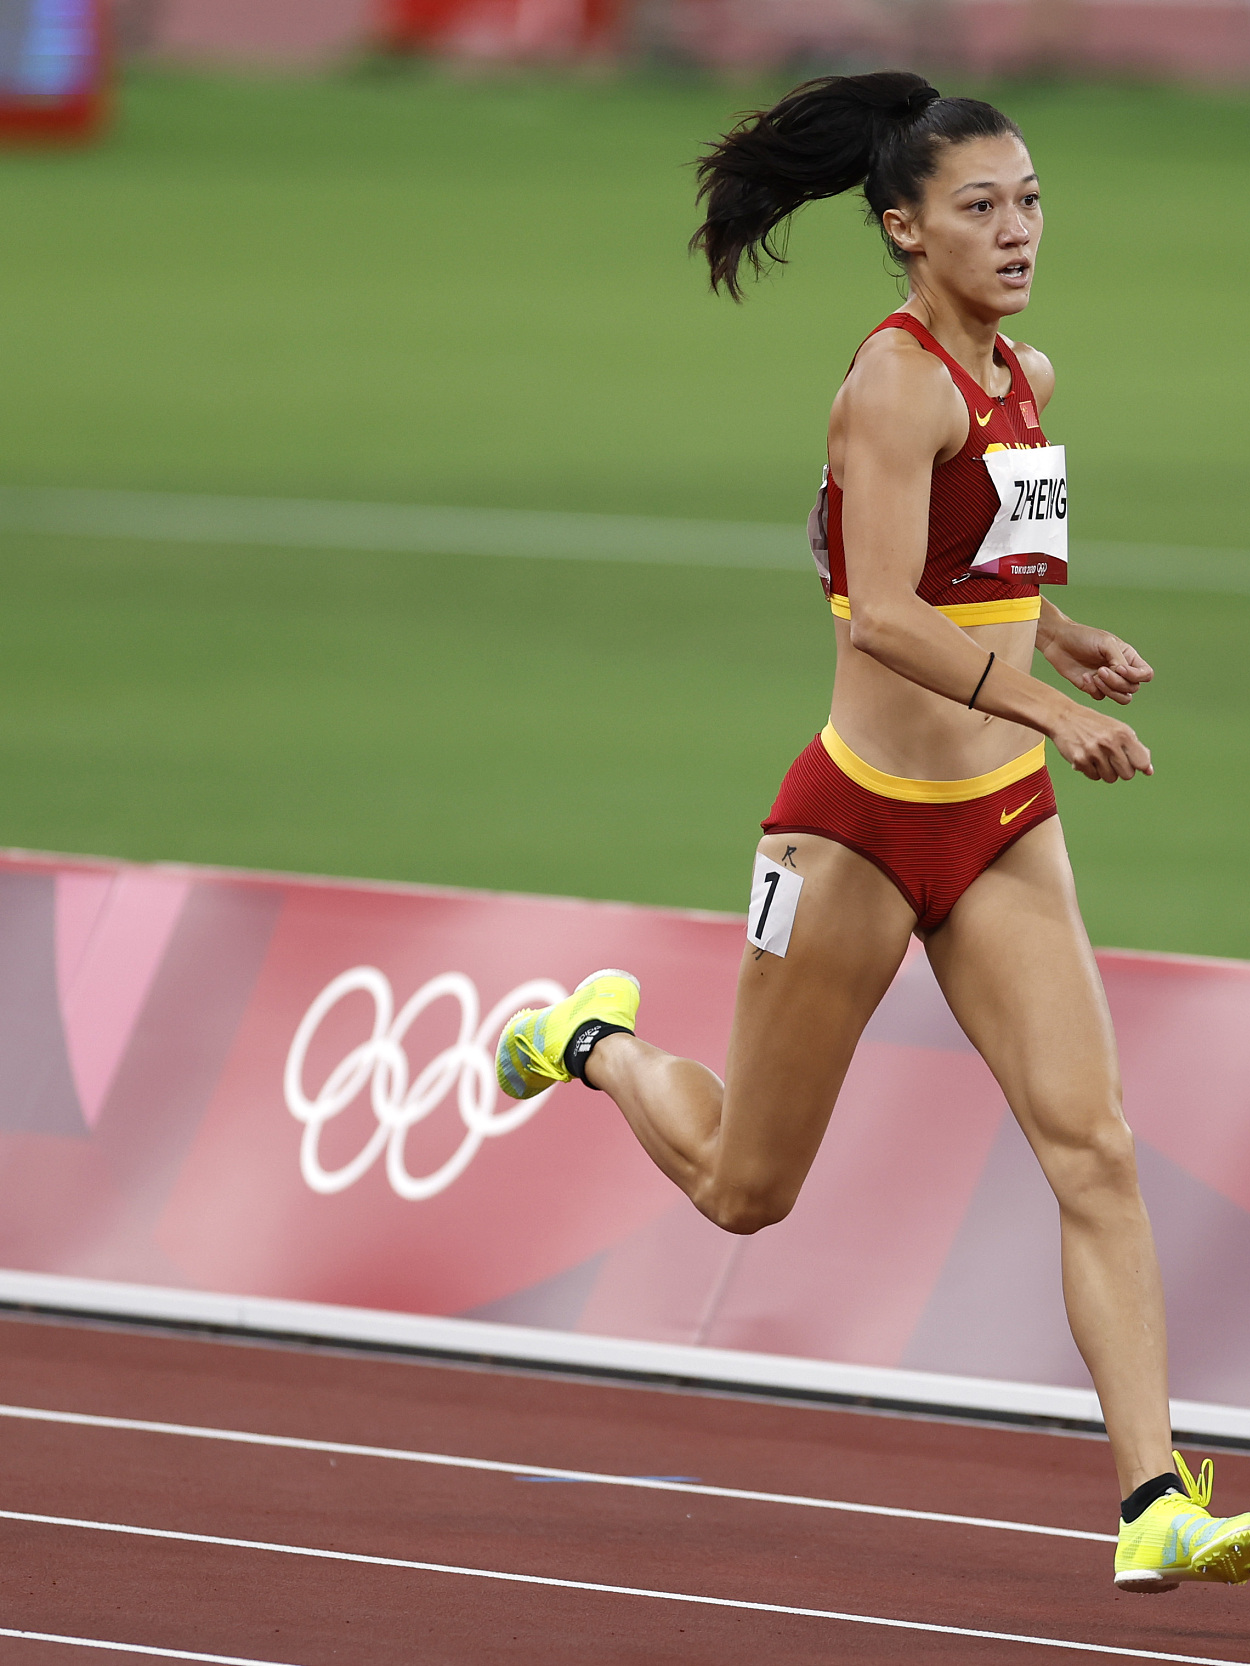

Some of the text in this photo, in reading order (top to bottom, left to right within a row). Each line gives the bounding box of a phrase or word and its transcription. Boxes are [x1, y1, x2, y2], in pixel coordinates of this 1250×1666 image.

[1010, 478, 1067, 521] ZHENG
[755, 871, 781, 940] 1
[573, 1025, 602, 1057] adidas
